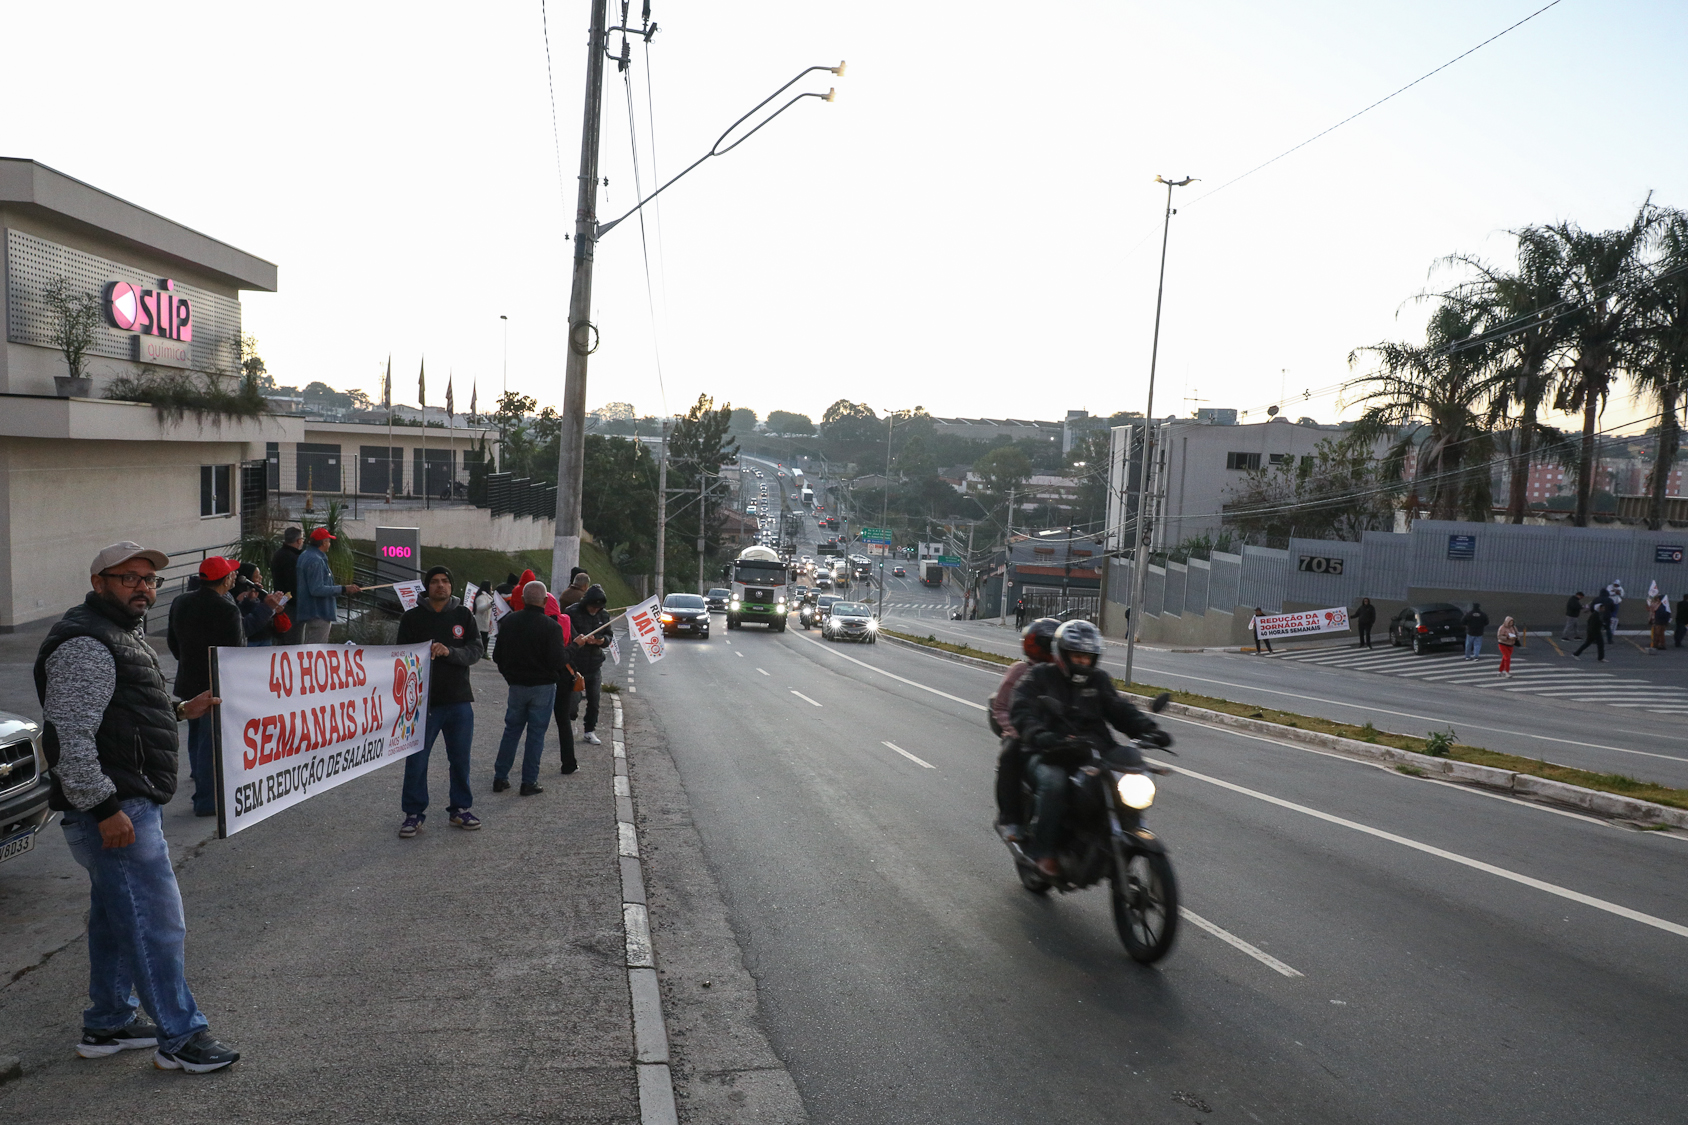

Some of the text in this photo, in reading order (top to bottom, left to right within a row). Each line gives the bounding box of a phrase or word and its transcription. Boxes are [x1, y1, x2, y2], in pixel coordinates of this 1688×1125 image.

[381, 545, 411, 558] 1060
[1300, 556, 1342, 574] 705
[631, 611, 655, 637] JÁ!
[1260, 614, 1303, 624] REDUÇÃO
[1260, 622, 1304, 631] JORNADA
[1269, 628, 1289, 636] HORAS
[1290, 625, 1321, 634] SEMANAIS
[269, 649, 367, 699] 40 HORAS
[243, 686, 384, 771] SEMANAIS JÁ!
[234, 737, 385, 818] SEM REDUÇÃO DE SALÁRIO!
